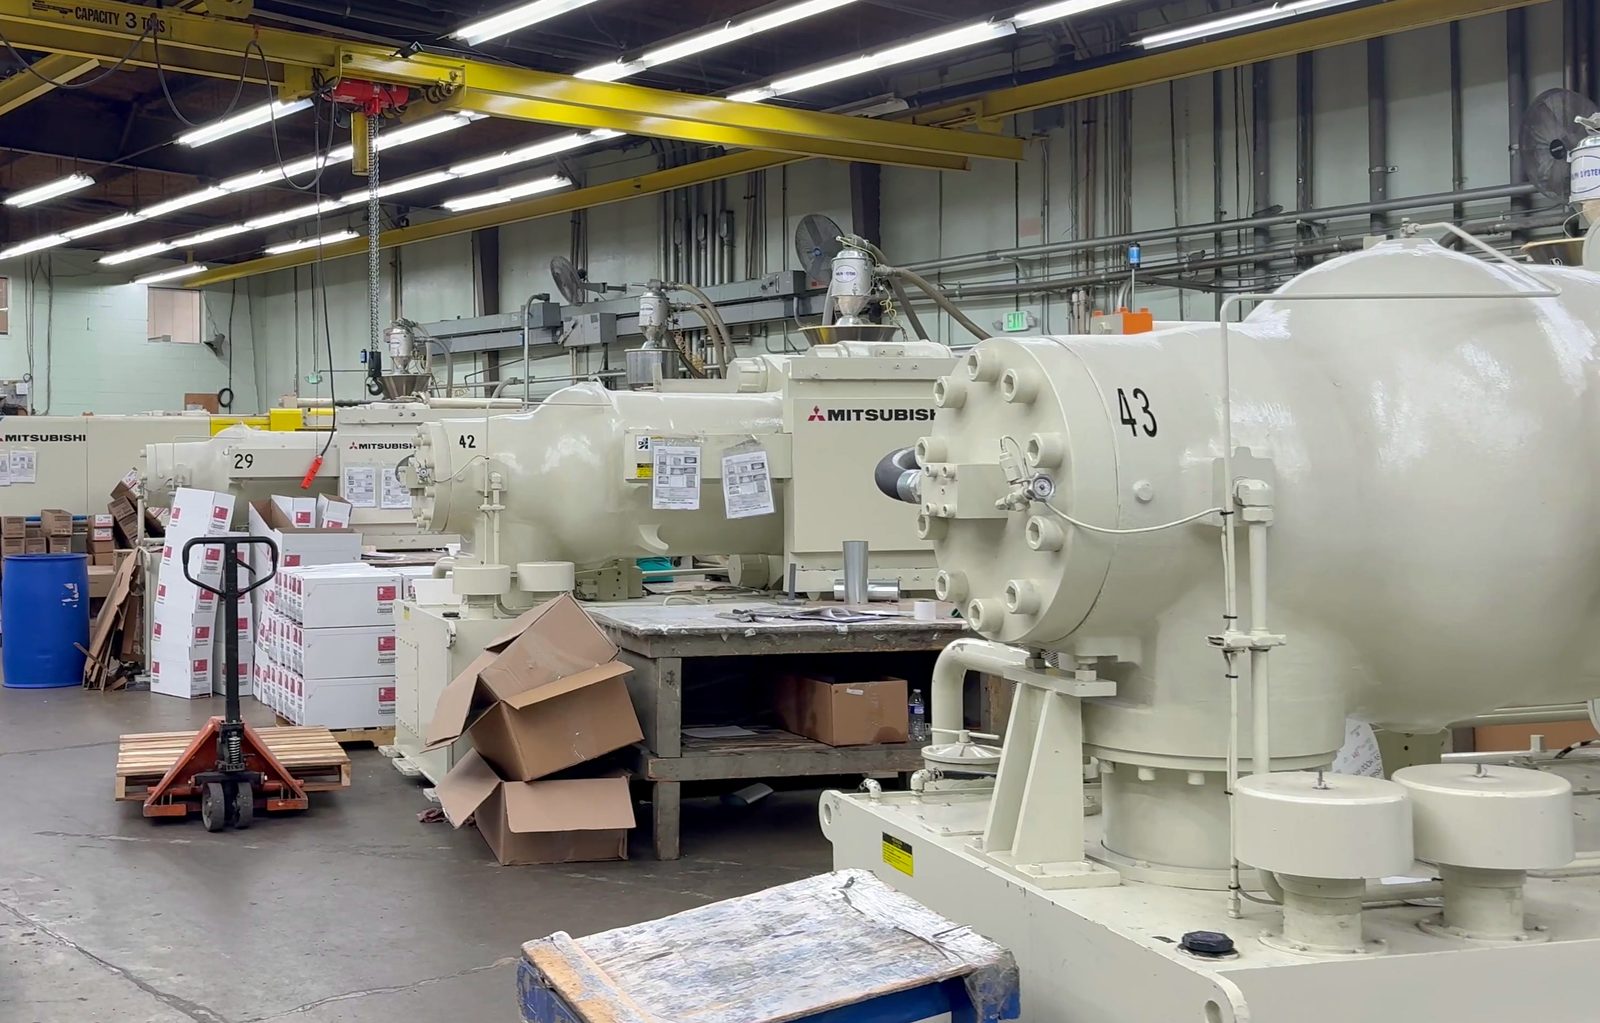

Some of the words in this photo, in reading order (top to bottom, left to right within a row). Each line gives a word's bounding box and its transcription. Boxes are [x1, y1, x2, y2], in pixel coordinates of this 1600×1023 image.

[75, 6, 120, 26] CAPACITY
[125, 12, 137, 29] 3
[1007, 312, 1025, 329] EXIT
[827, 408, 936, 421] MITSUBIS
[1117, 387, 1158, 438] 43
[5, 434, 86, 442] MITSUBISHI
[459, 434, 476, 449] 42
[234, 453, 254, 469] 29
